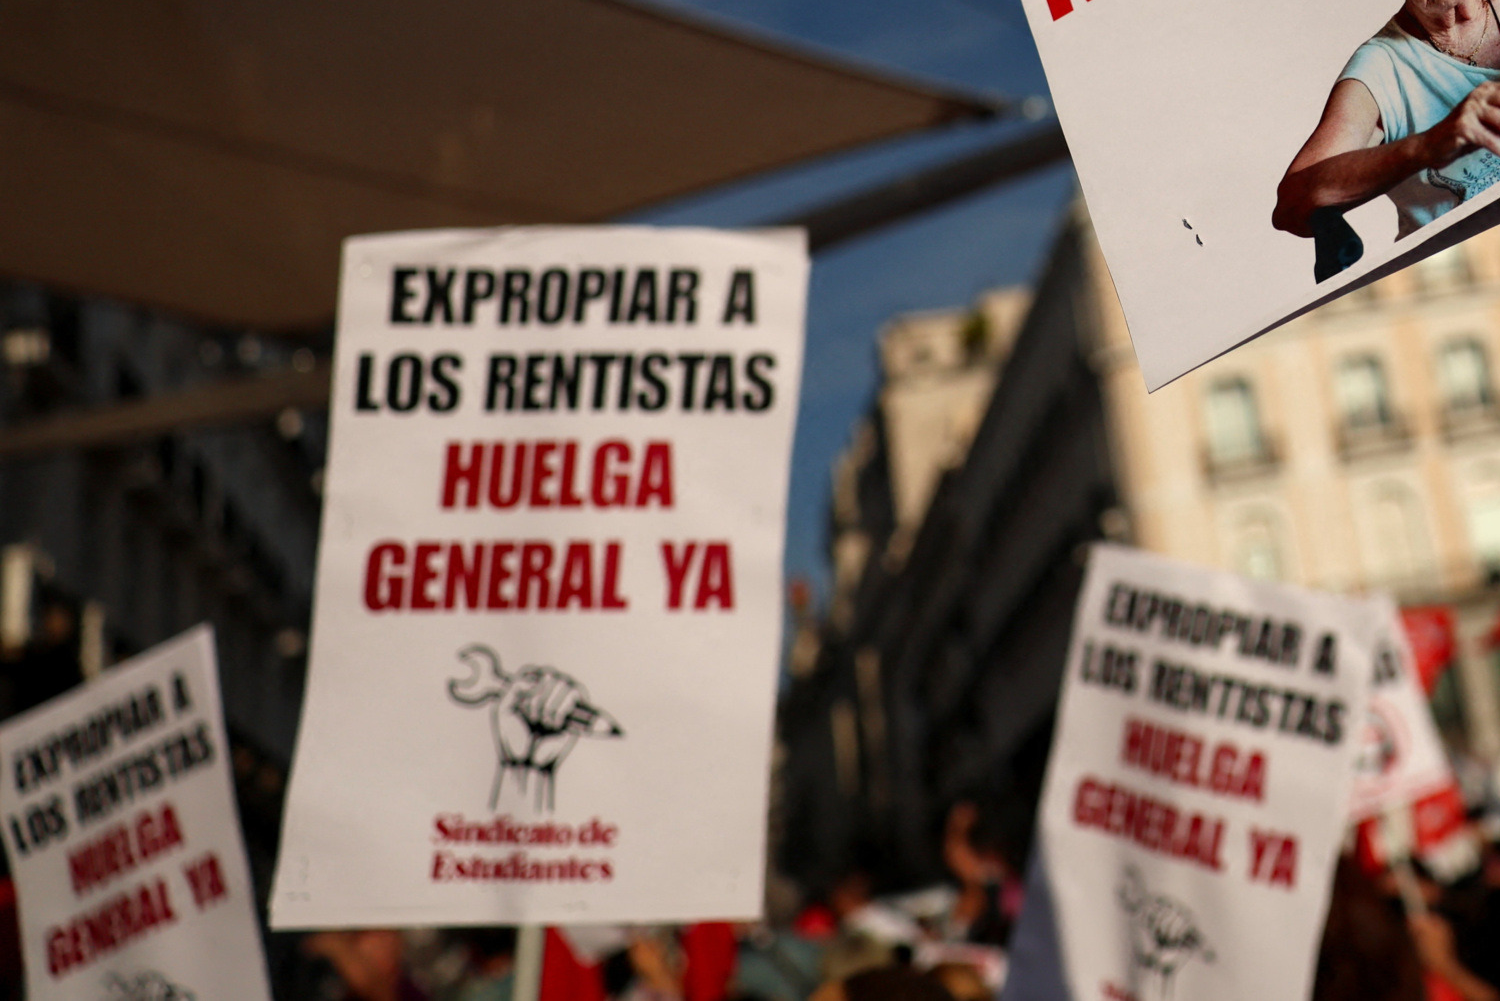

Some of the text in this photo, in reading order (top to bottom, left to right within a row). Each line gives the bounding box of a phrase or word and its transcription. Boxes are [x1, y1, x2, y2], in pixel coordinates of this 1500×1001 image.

[389, 268, 756, 326] EXPROPIAR A
[355, 353, 776, 413] LOS RENTISTAS
[440, 440, 675, 510] HUELGA
[363, 539, 735, 611] GENERAL YA
[1105, 582, 1303, 668] EXPROPIAR
[1314, 631, 1337, 676] A
[13, 672, 191, 791] EXPROPIAR A
[1081, 639, 1346, 745] LOS RENTISTAS
[9, 722, 215, 854] LOS RENTISTAS
[1122, 716, 1268, 803] HUELGA
[67, 801, 184, 897] HUELGA
[431, 852, 613, 883] Estudiantes
[432, 814, 617, 846] Sindicato de
[1072, 776, 1300, 888] GENERAL YA
[46, 850, 228, 981] GENERAL YA
